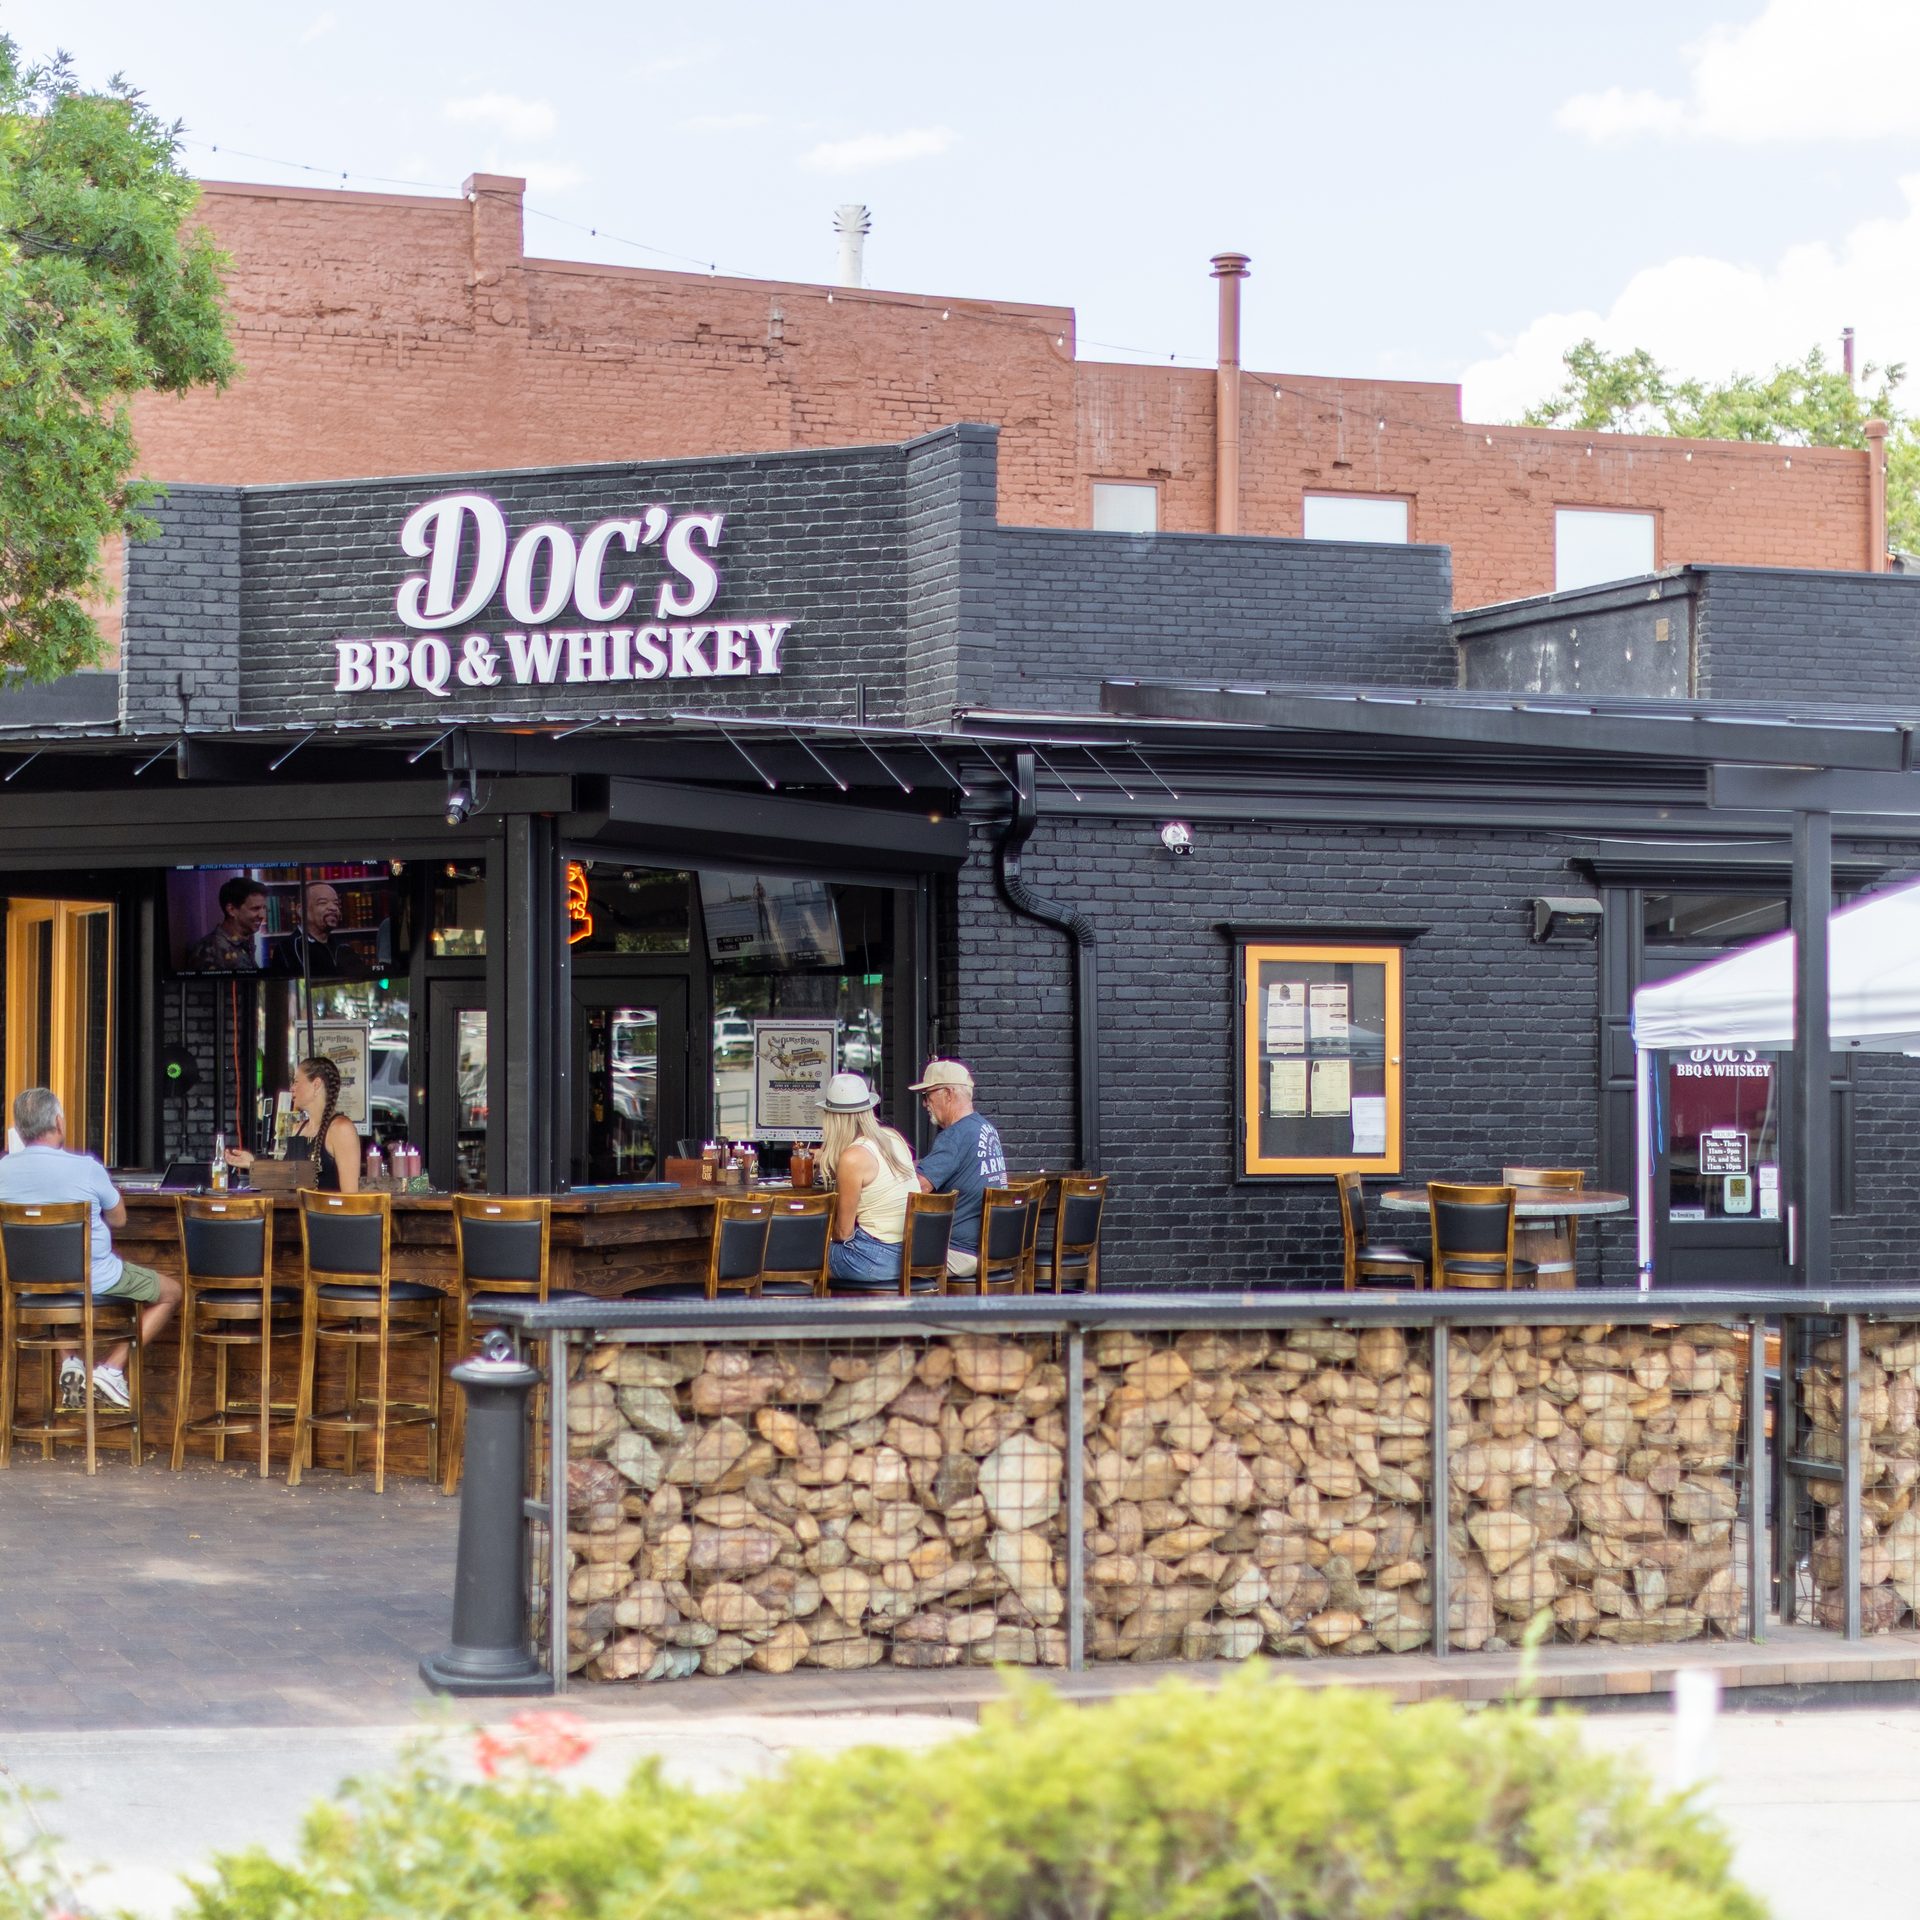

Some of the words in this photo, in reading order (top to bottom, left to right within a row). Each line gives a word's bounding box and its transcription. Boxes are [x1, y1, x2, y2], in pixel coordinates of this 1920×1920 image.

[397, 495, 723, 630] DOC'S
[335, 638, 451, 697] BBQ
[457, 635, 502, 687] &
[505, 622, 792, 683] WHISKEY
[1677, 1064, 1702, 1078] BBQ
[1703, 1064, 1712, 1077] &
[1713, 1064, 1771, 1077] WHISKEY
[1690, 1049, 1757, 1063] OCS
